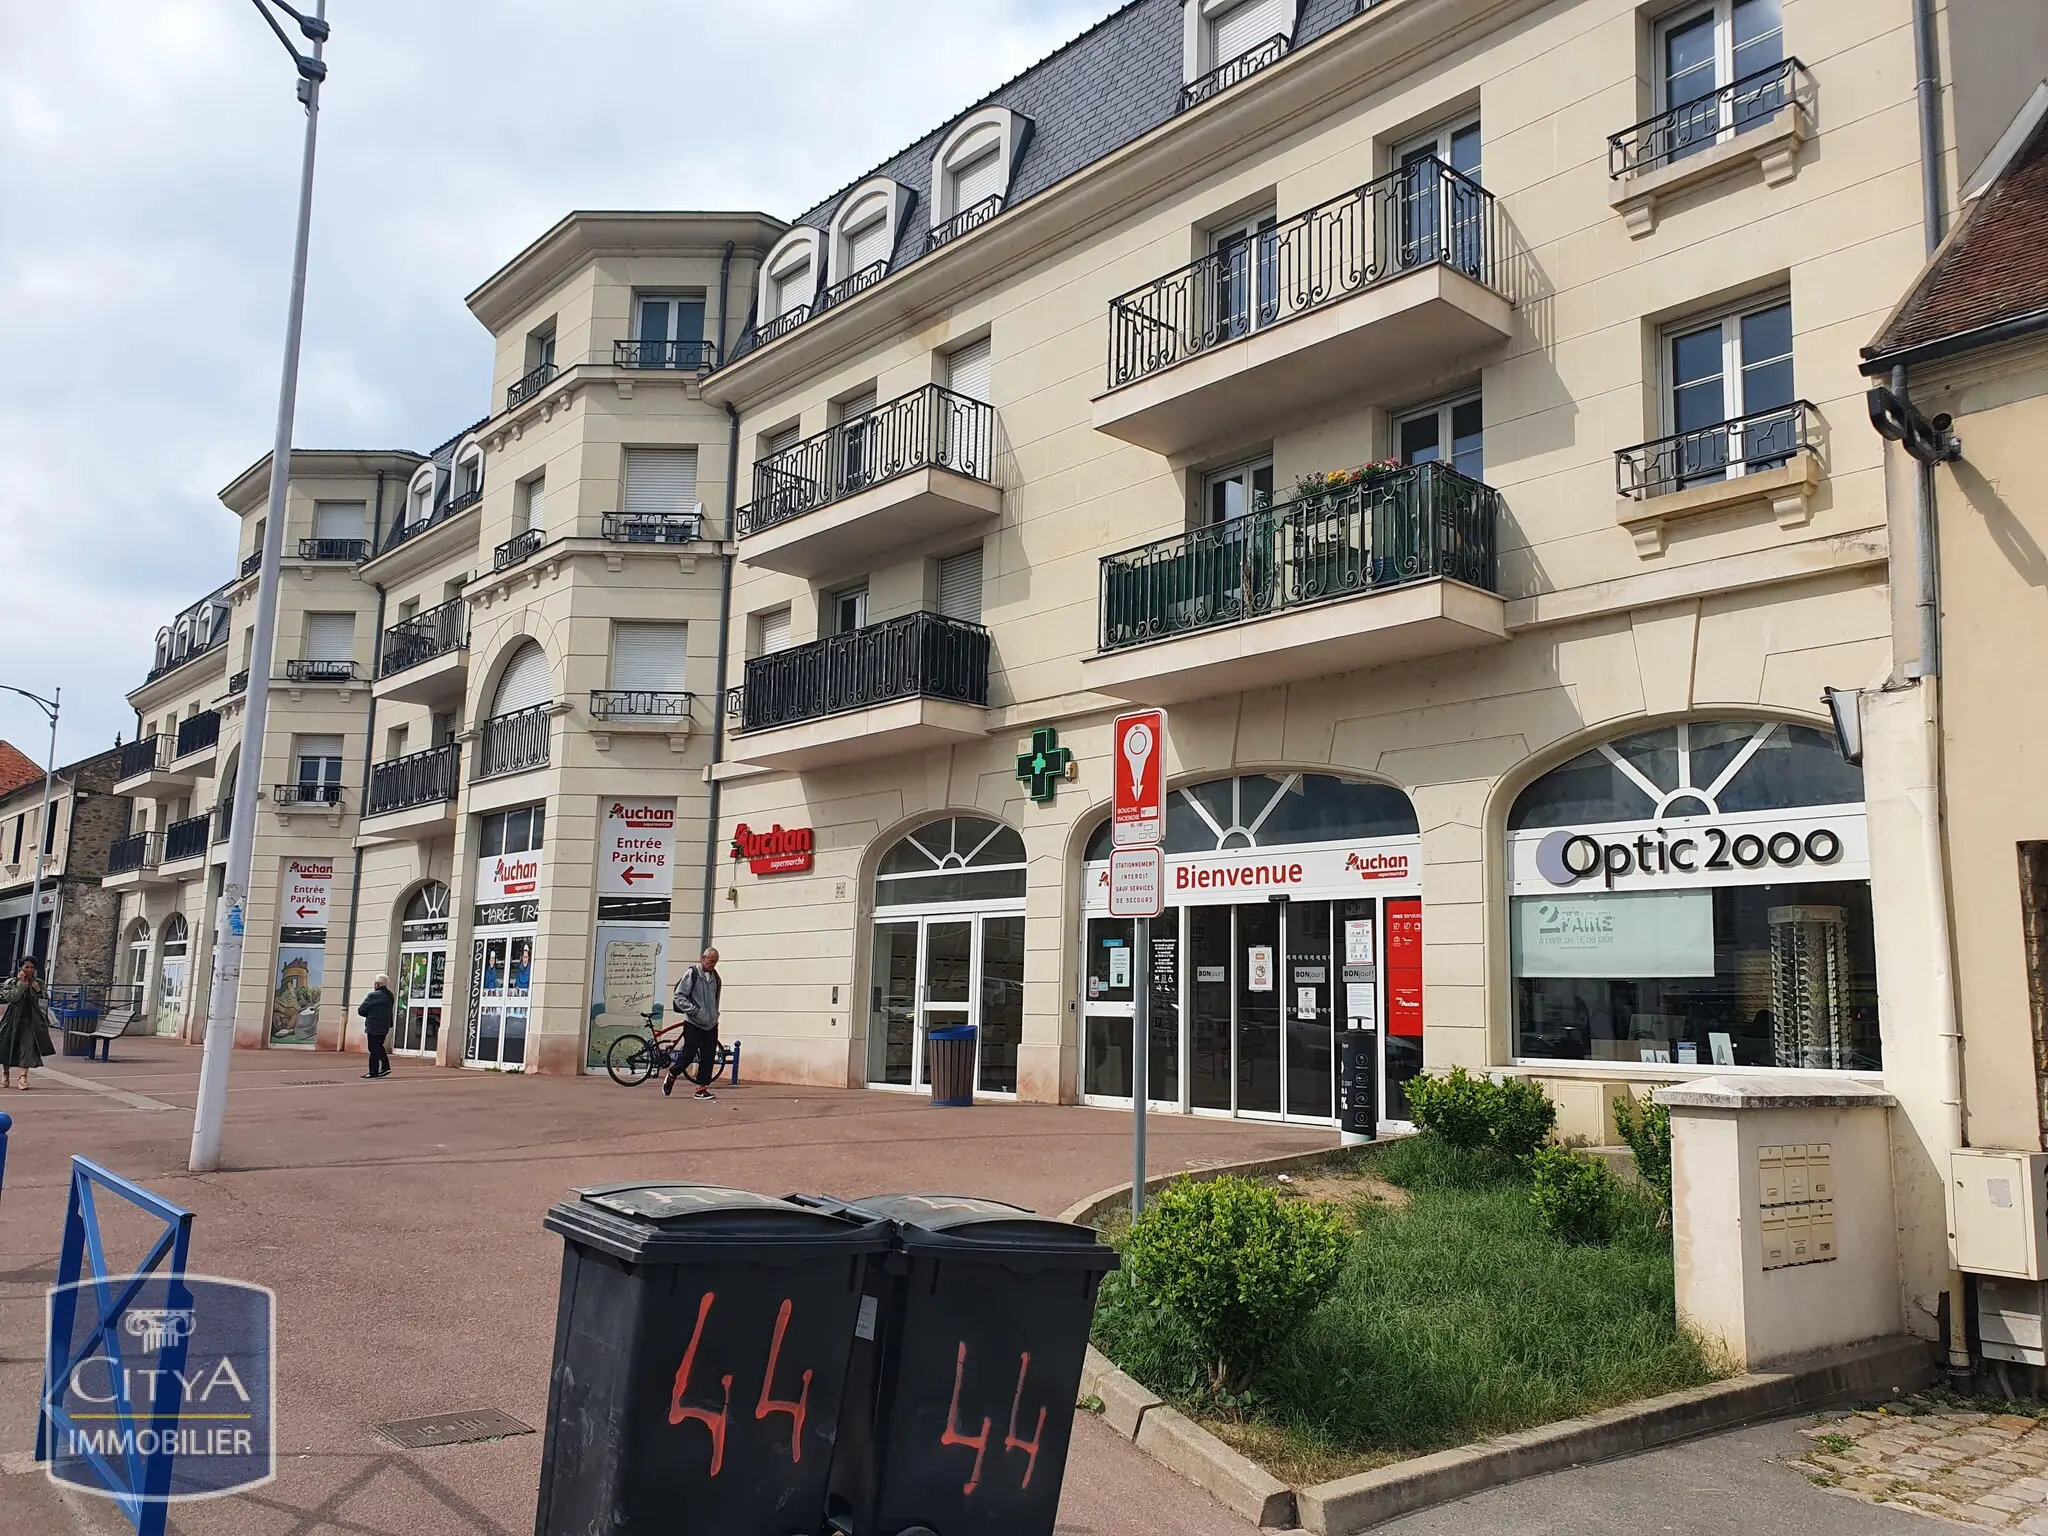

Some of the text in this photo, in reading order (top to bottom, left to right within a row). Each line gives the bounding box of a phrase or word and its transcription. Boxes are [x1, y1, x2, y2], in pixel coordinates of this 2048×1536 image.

[608, 803, 674, 820] Auchan
[1117, 806, 1138, 815] BOUCHE
[1116, 813, 1140, 823] INCENDIE
[617, 837, 662, 849] Entrée
[730, 823, 813, 858] Auchan
[612, 851, 665, 866] Parking
[770, 857, 805, 869] supermarché
[1344, 852, 1409, 871] Auchan
[1562, 826, 1840, 888] Optic 2000
[289, 861, 333, 873] Auchan
[493, 858, 537, 883] Auchan
[1115, 861, 1155, 869] STATIONNEMENT
[1176, 863, 1303, 890] Bienvenue
[293, 885, 325, 894] Entrée
[290, 895, 326, 906] Parking
[1126, 896, 1153, 904] SECOURS
[481, 905, 516, 924] MARÉE
[1198, 970, 1224, 978] BONjour!
[1295, 970, 1325, 979] BONjour!
[1344, 969, 1374, 980] BONjour!
[668, 1291, 814, 1478] 44
[940, 1340, 1048, 1496] 44
